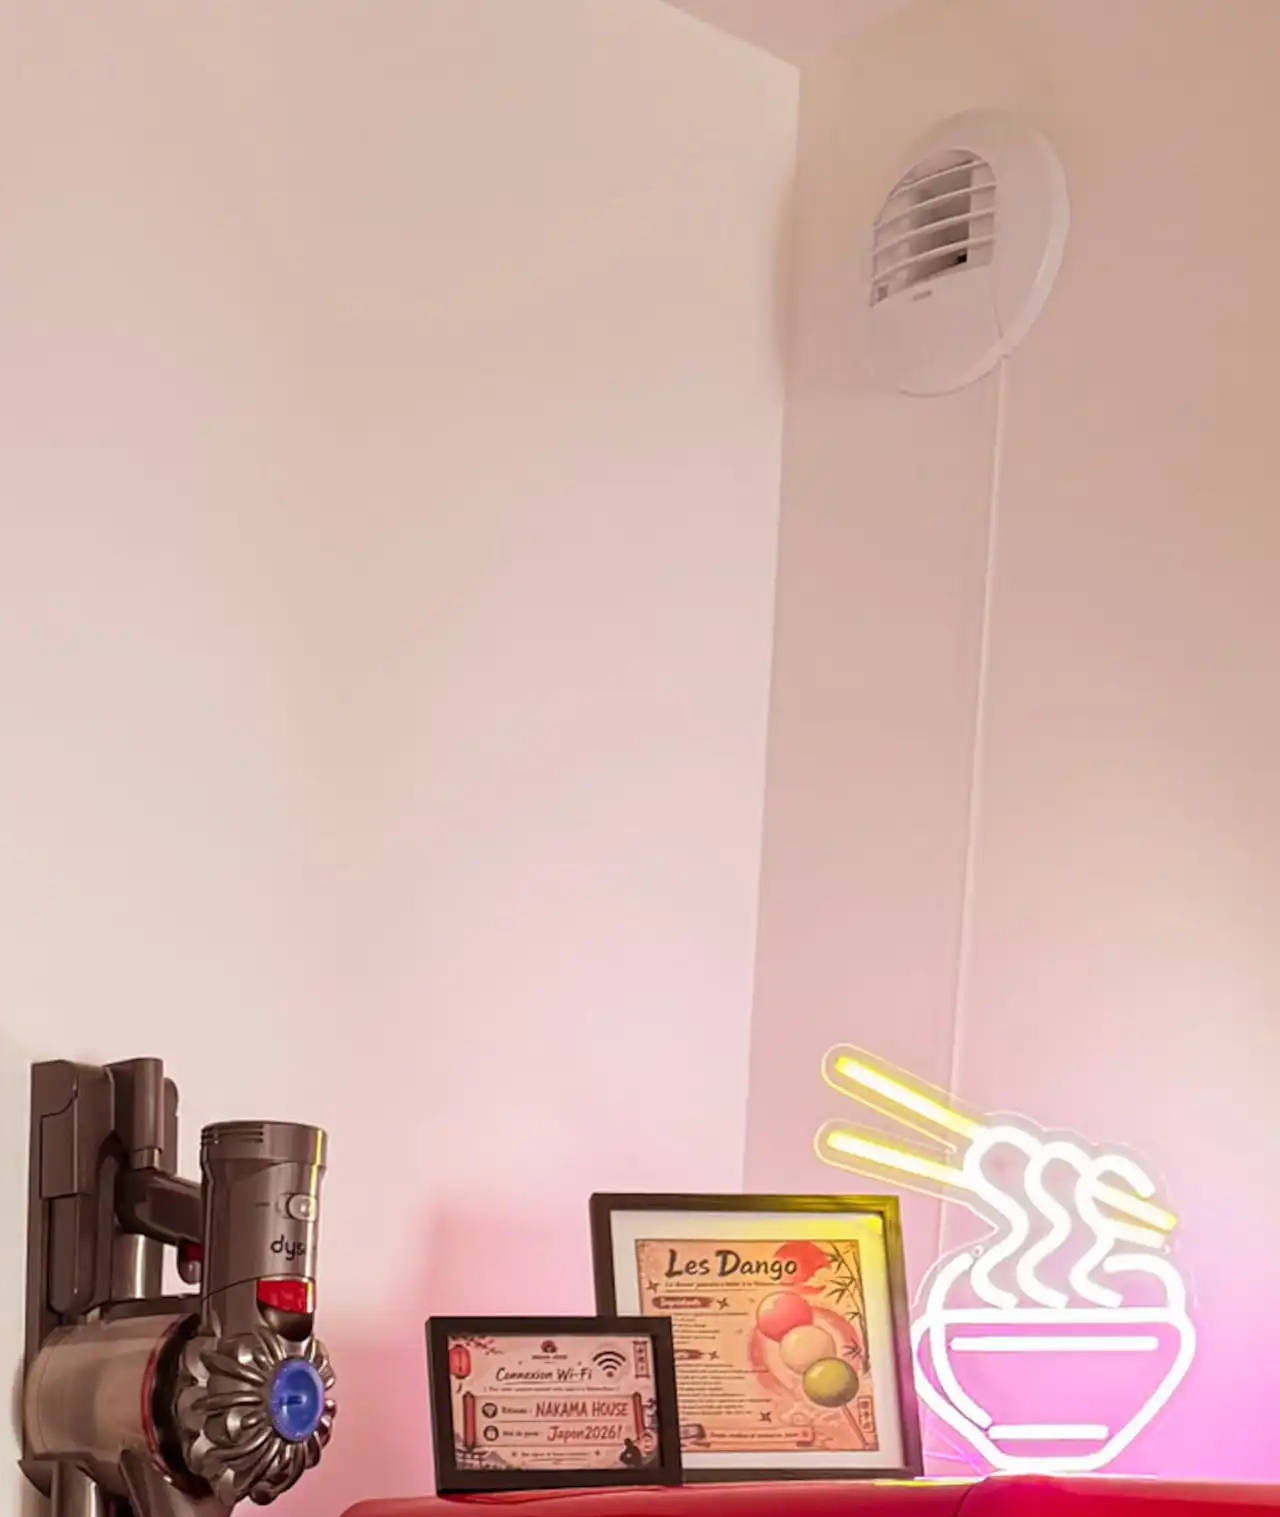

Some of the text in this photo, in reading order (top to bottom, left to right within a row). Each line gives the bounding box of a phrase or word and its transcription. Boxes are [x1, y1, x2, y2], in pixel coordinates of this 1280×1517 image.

[270, 1234, 308, 1261] dys
[665, 1248, 797, 1281] Les Dango
[496, 1367, 592, 1382] Connexion Wi-Fi
[535, 1402, 587, 1417] NAKAMA
[591, 1402, 628, 1416] HOUSE
